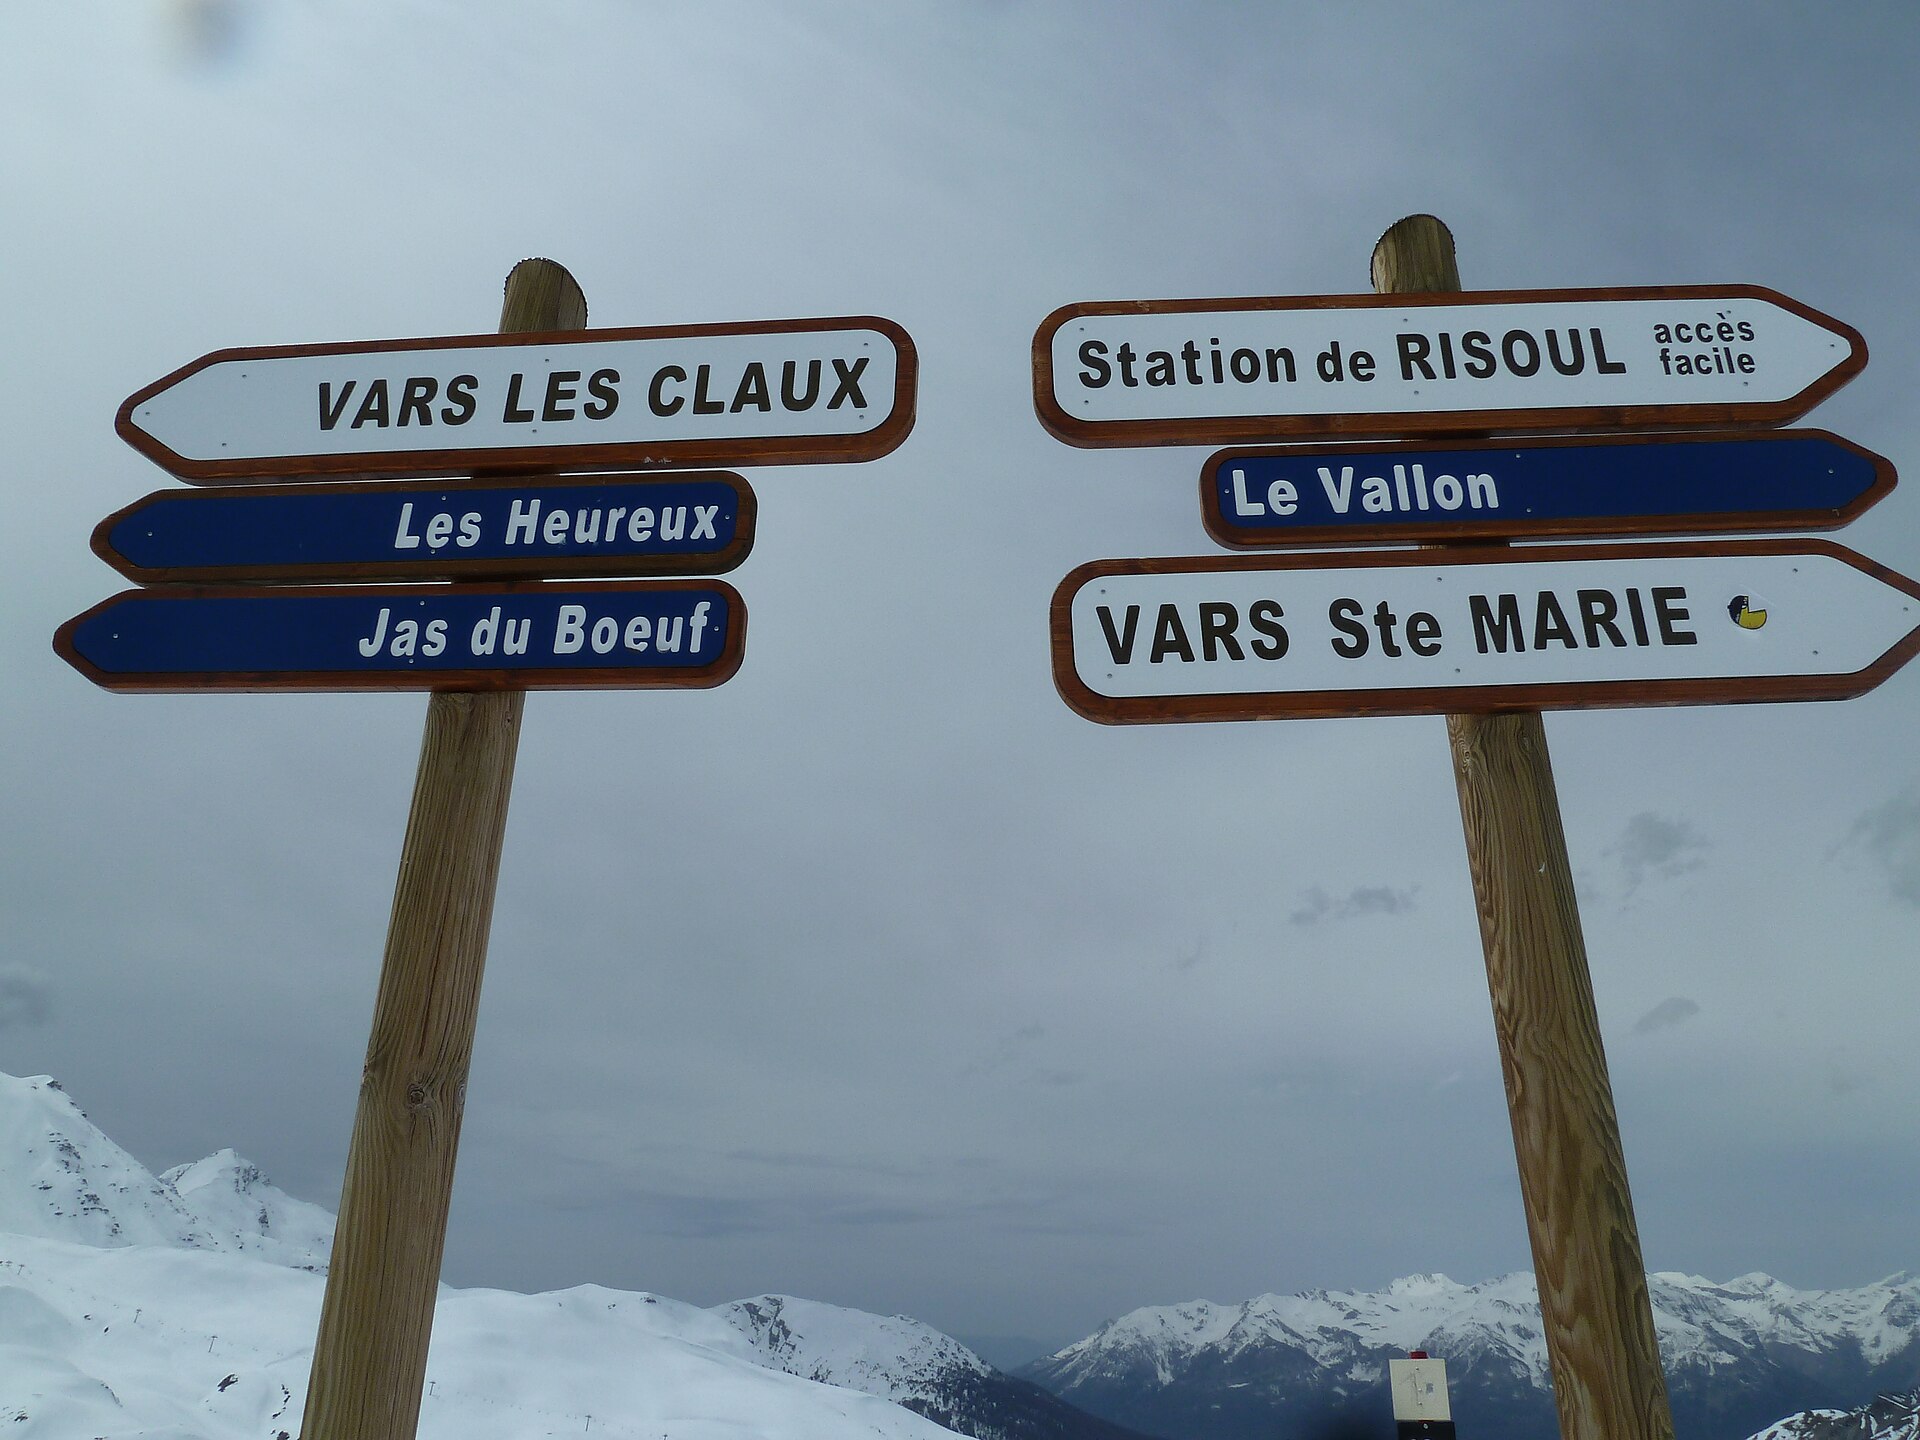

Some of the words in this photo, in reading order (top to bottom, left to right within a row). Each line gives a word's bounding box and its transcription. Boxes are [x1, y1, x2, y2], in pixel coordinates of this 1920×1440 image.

[1653, 312, 1755, 344] accès
[1078, 337, 1297, 389] Station
[1316, 340, 1376, 383] de
[1395, 327, 1627, 381] RISOUL
[1659, 346, 1756, 376] facile
[318, 374, 479, 431] VARS
[502, 368, 621, 424] LES
[647, 357, 870, 418] CLAUX
[1232, 469, 1299, 516] Le
[1316, 463, 1499, 514] Vallon
[394, 502, 482, 549] Les
[504, 498, 719, 545] Heureux
[358, 608, 449, 658] Jas
[470, 606, 532, 656] du
[553, 601, 711, 654] Boeuf
[1095, 599, 1290, 665] VARS
[1328, 597, 1443, 659] Ste
[1468, 586, 1698, 654] MARIE
